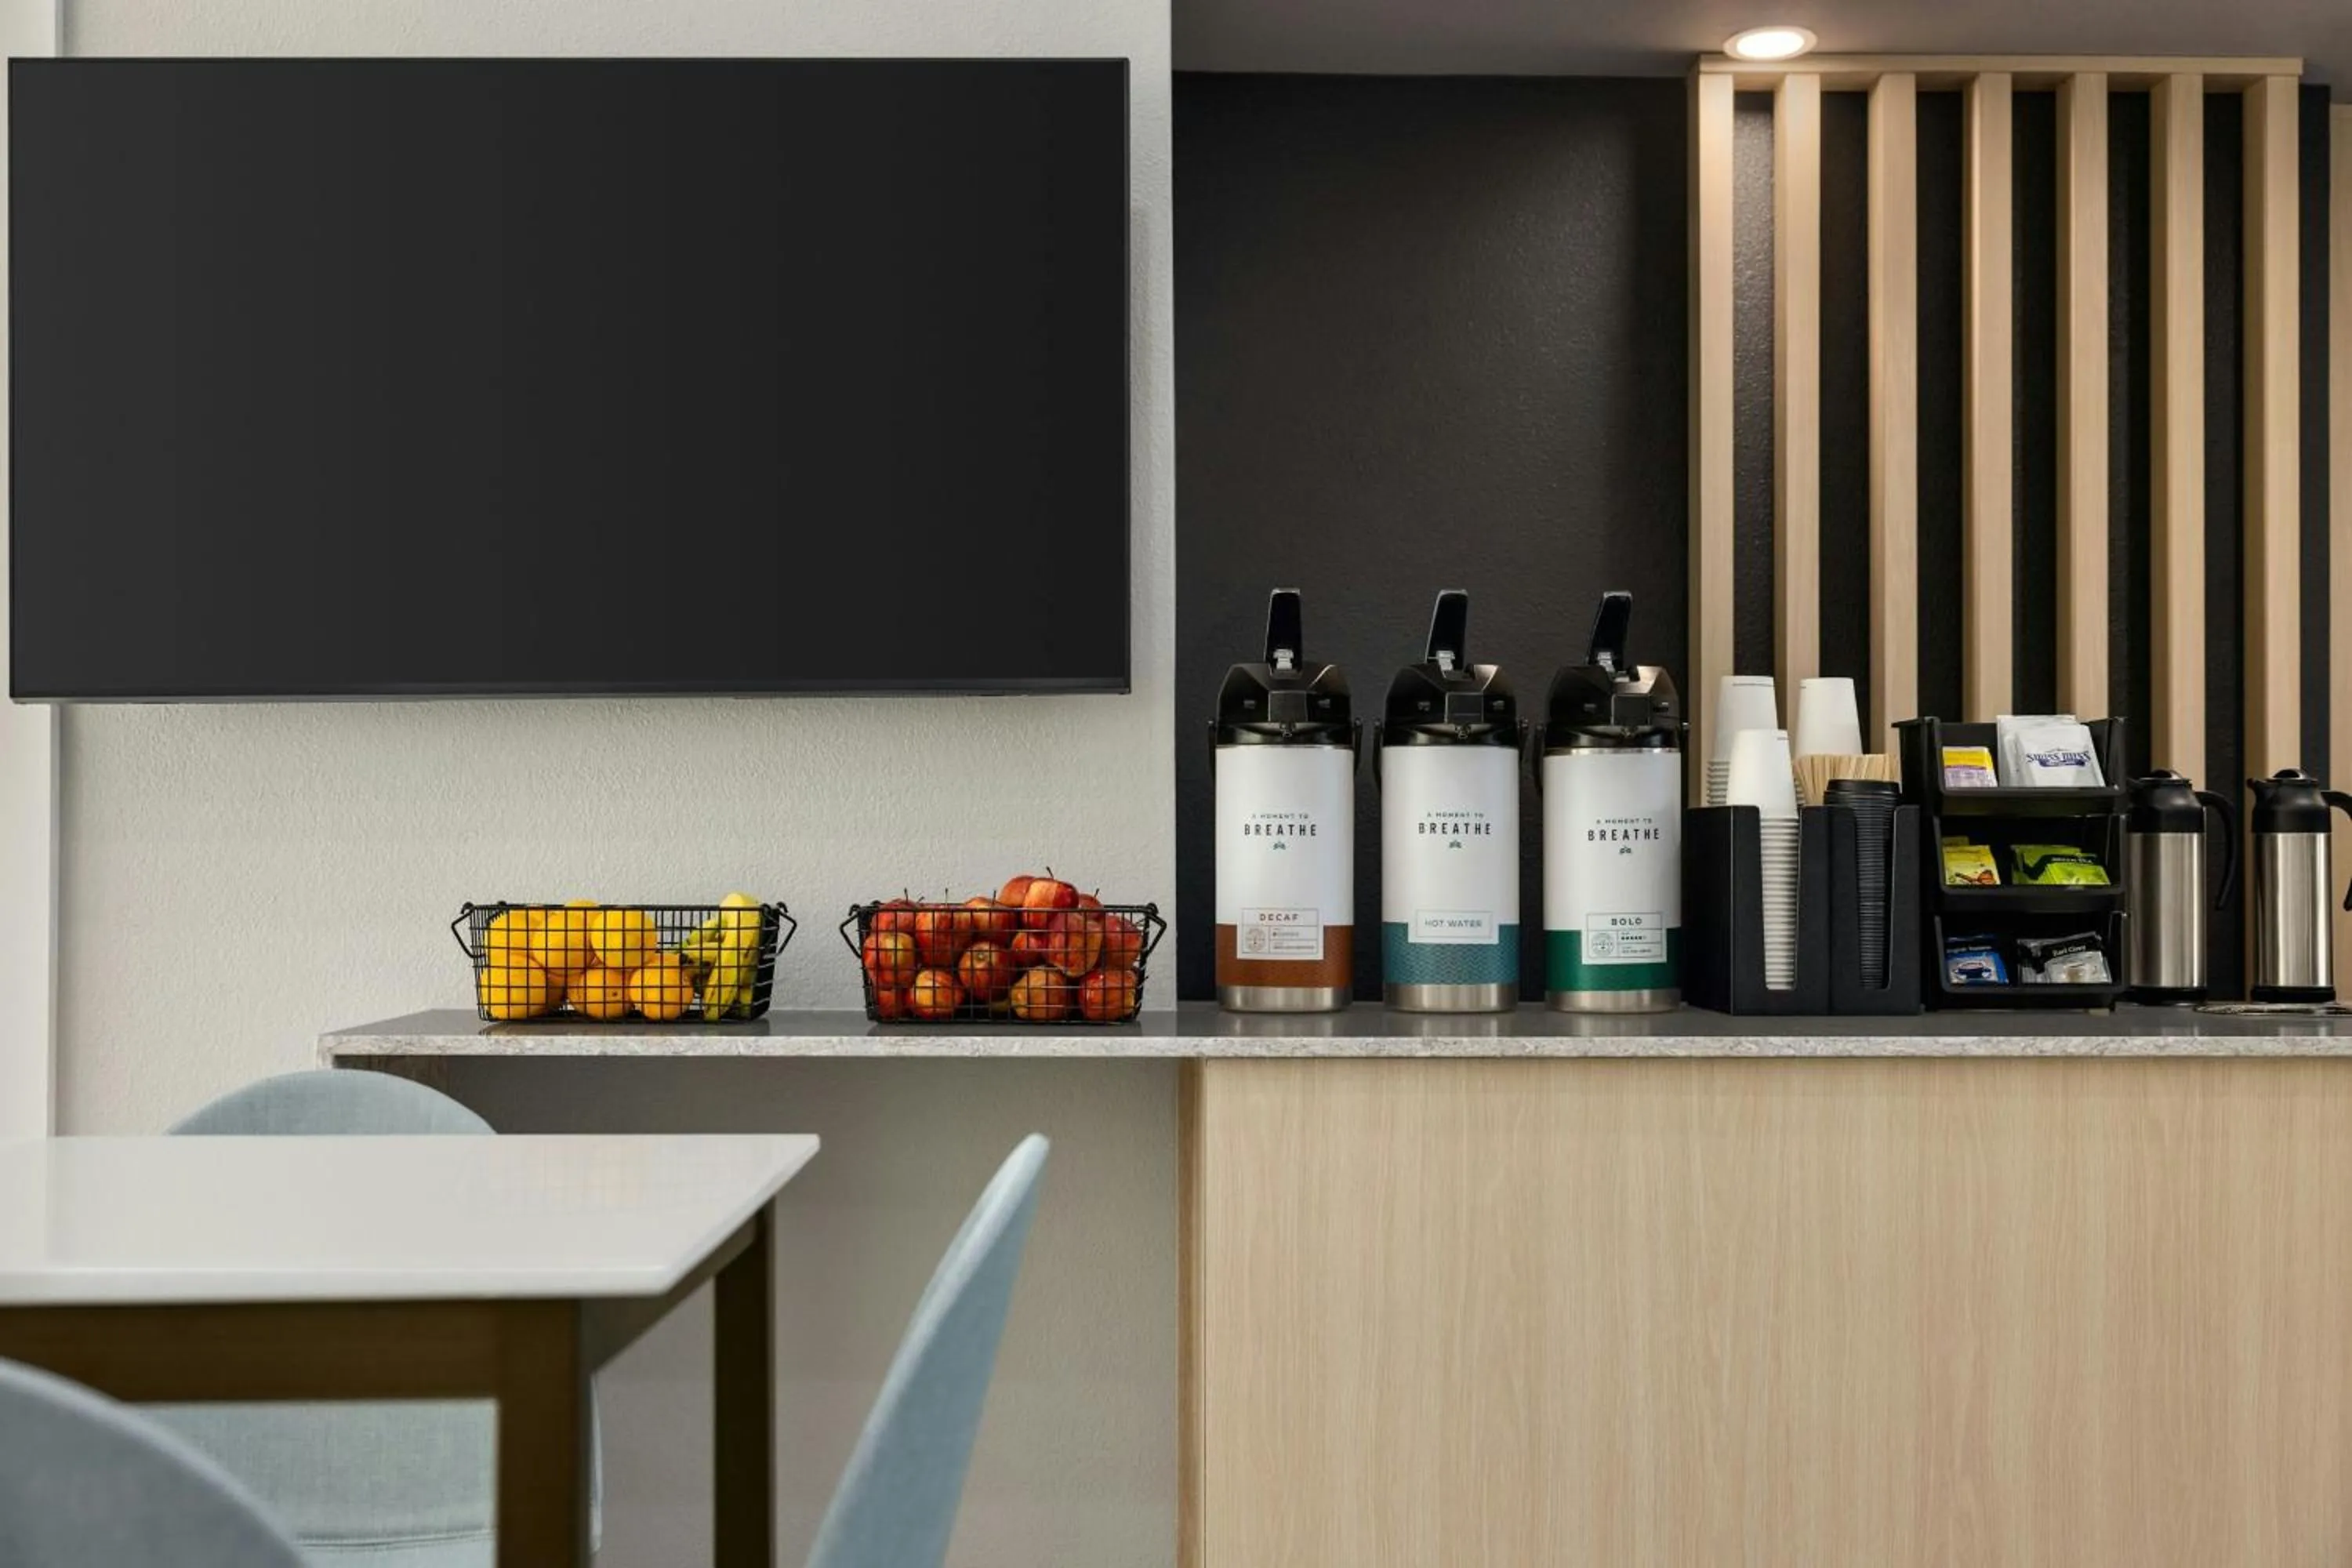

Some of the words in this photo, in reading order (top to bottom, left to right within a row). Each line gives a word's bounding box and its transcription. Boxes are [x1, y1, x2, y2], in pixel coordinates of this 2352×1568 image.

[1244, 824, 1317, 837] BREATHE
[1418, 822, 1491, 835] BREATHE
[1588, 828, 1660, 841] BREATHE
[1425, 919, 1444, 927] HOT
